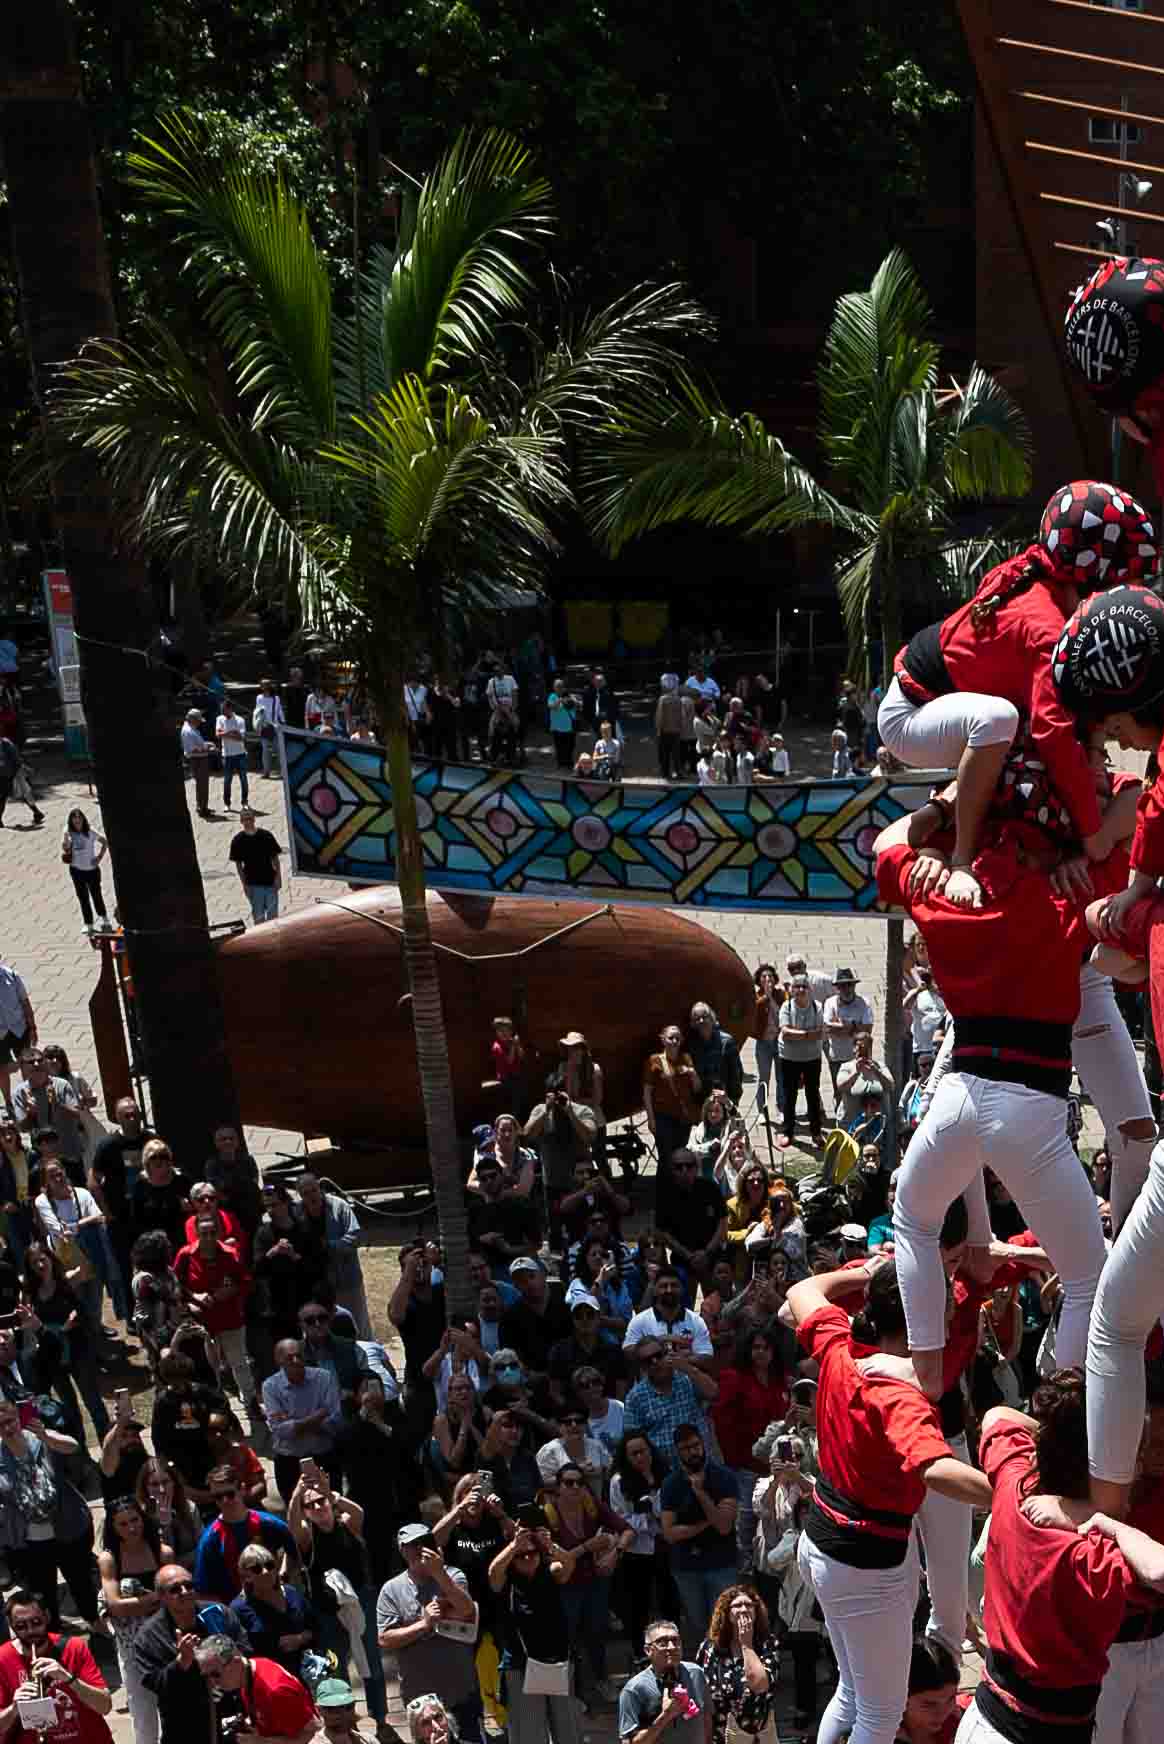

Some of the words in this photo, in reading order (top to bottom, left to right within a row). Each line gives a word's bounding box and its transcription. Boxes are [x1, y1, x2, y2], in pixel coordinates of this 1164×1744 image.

[1093, 298, 1109, 310] DE
[1090, 610, 1107, 626] DE
[1109, 605, 1161, 656] BARCELONA
